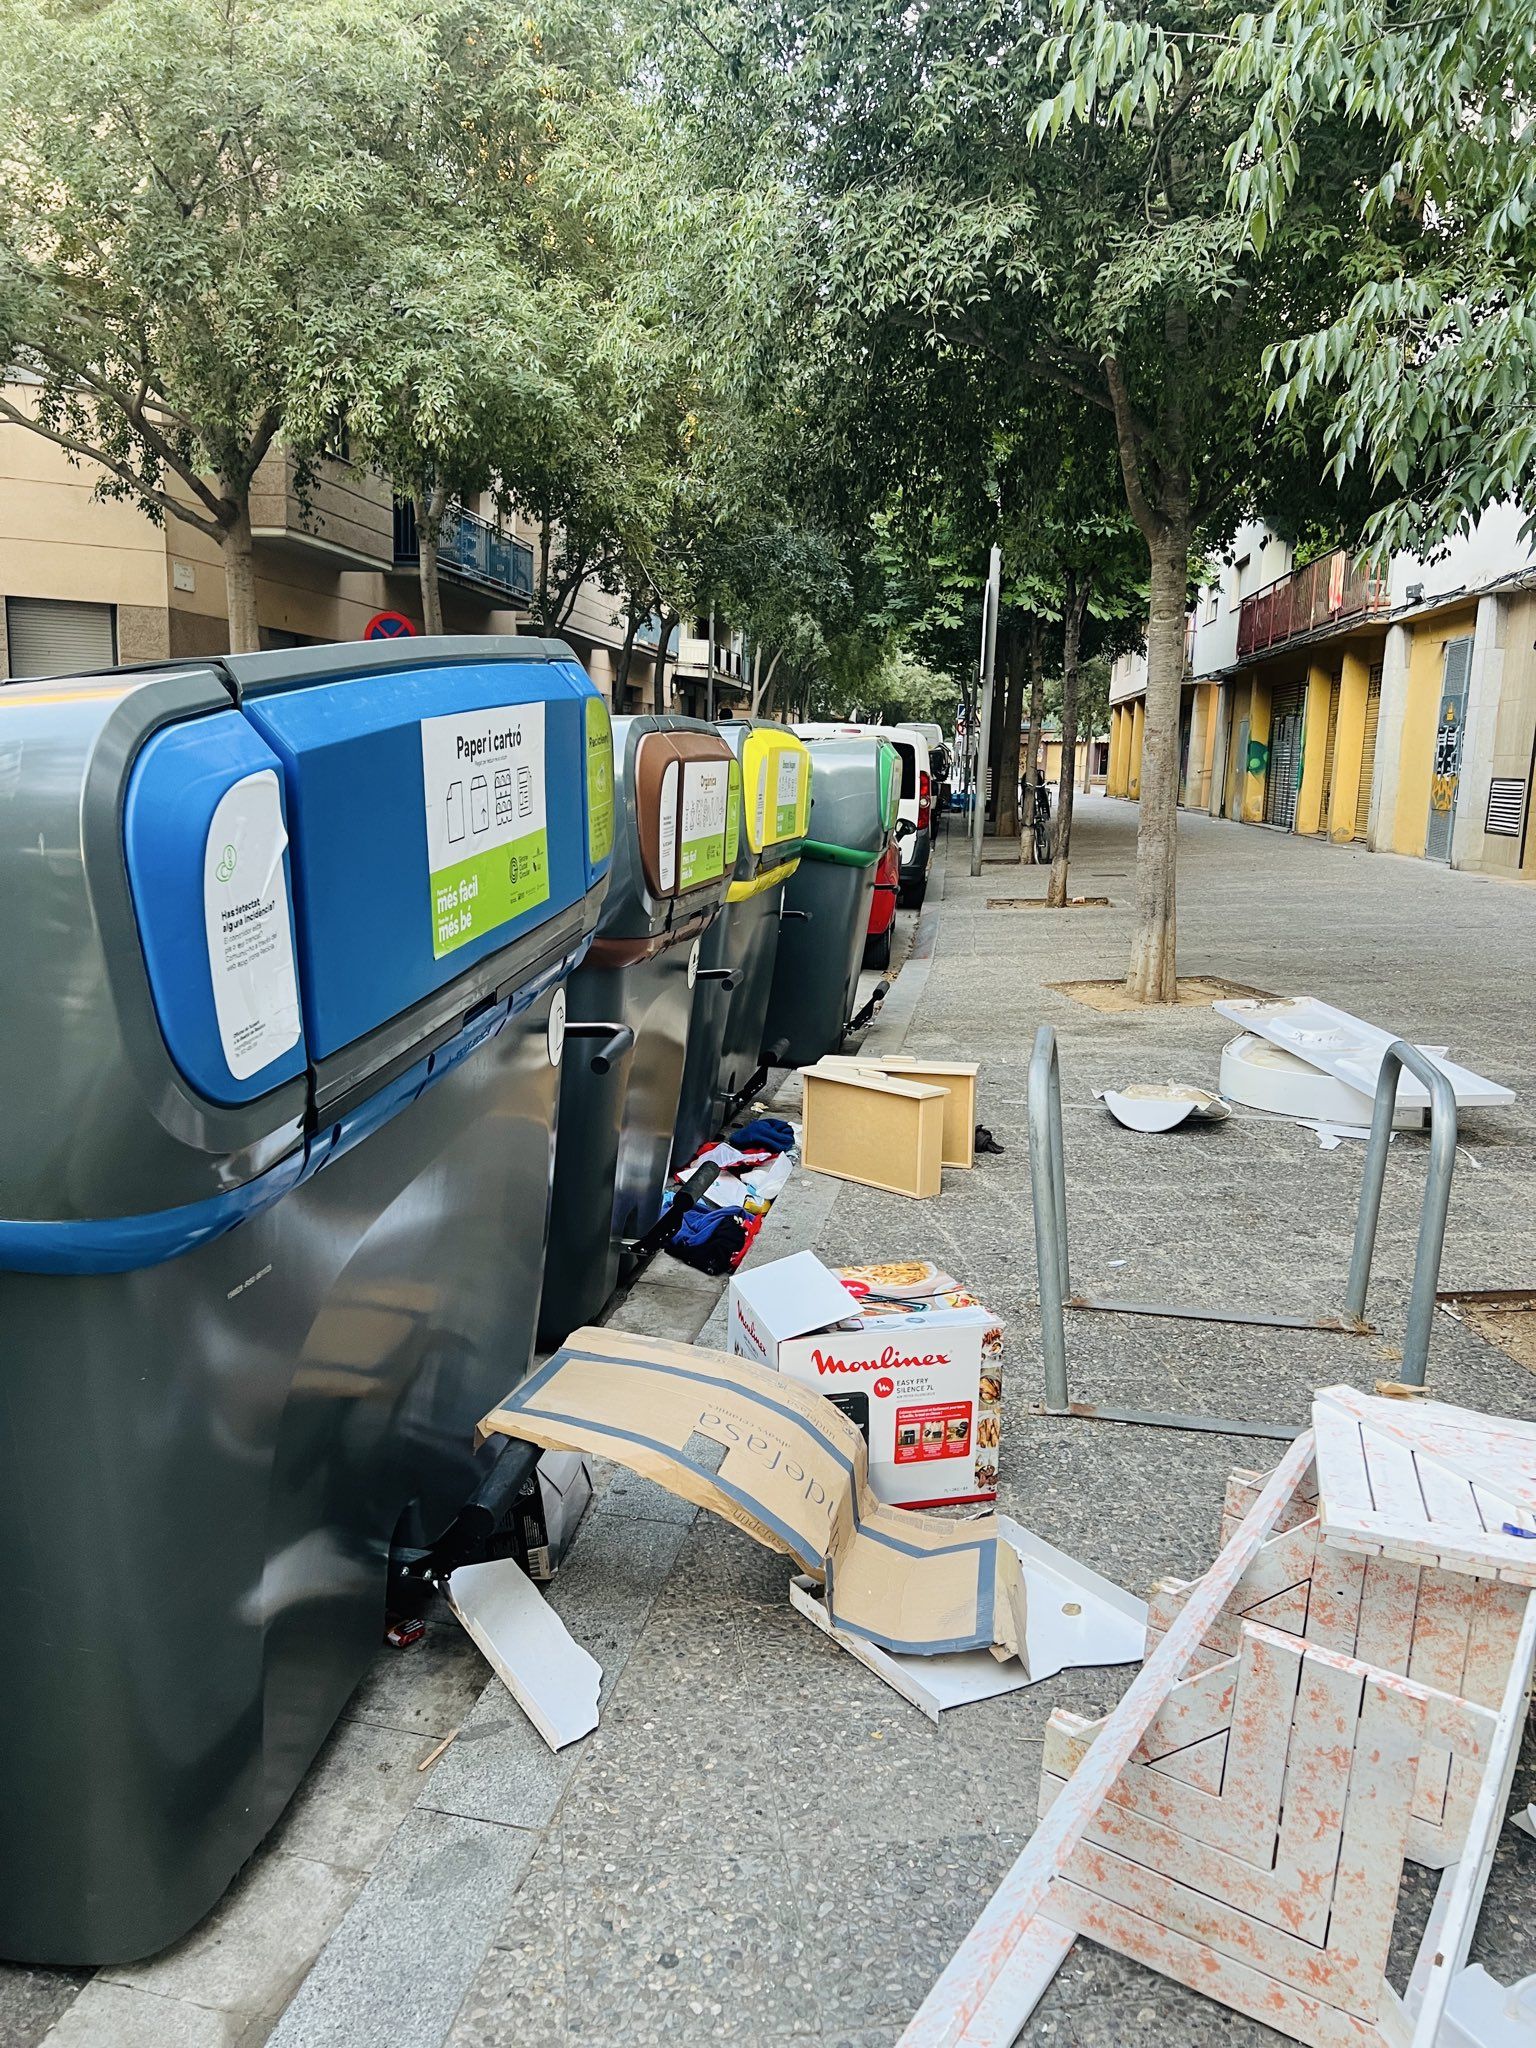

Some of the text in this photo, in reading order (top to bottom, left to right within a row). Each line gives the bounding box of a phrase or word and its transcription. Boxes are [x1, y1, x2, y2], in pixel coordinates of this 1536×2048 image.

[456, 735, 487, 763] Paper
[488, 729, 492, 752] i
[493, 723, 522, 751] cartró
[221, 898, 261, 921] Has detectat
[437, 886, 458, 914] més
[222, 918, 243, 933] alguna
[438, 905, 472, 943] més bé
[811, 1346, 951, 1376] Moulinex
[896, 1385, 925, 1394] SILENCE
[916, 1377, 929, 1385] FRY
